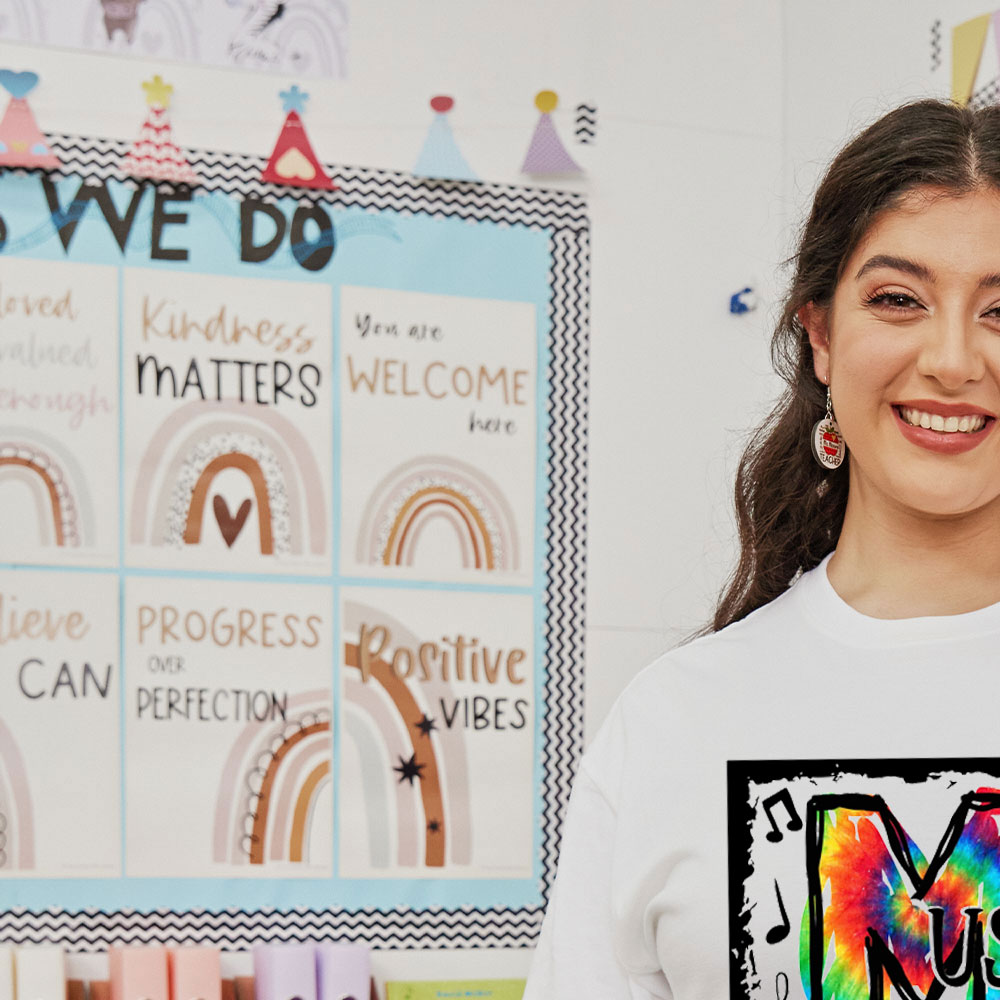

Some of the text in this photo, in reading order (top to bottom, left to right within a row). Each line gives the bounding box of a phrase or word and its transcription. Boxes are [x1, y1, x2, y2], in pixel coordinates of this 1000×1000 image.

[41, 174, 192, 261] WE
[240, 196, 336, 272] DO
[141, 295, 316, 354] Kindness
[356, 312, 443, 341] You are
[347, 355, 529, 405] WELCOME
[469, 411, 517, 435] here
[137, 605, 323, 648] PROGRESS
[149, 655, 186, 675] OVER
[358, 623, 527, 685] Positive
[18, 658, 112, 700] CAN
[136, 687, 288, 722] PERFECTION
[439, 696, 529, 730] VIBES
